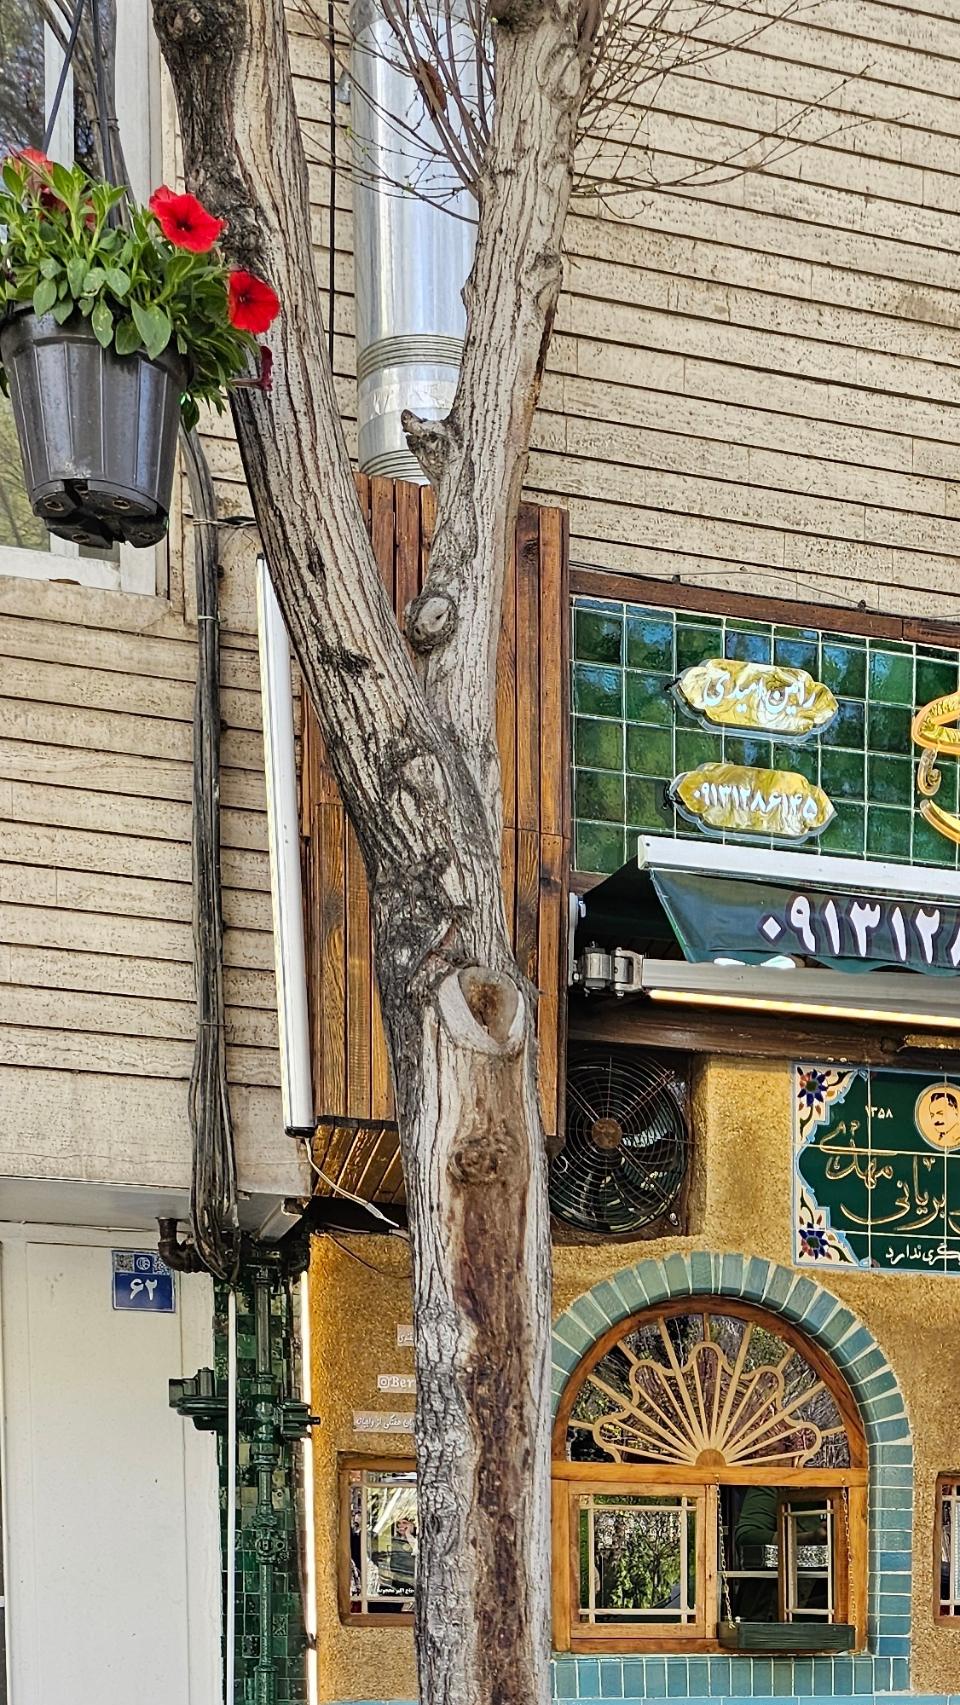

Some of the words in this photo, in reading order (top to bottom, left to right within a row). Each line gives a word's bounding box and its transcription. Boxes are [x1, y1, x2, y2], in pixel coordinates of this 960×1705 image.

[763, 676, 816, 716] رامین
[693, 782, 818, 821] ۰۹۱۳۱۲۸۶۱۴۵
[864, 1105, 894, 1119] ۱۳۵۸
[819, 1119, 898, 1190] مهدی
[840, 1155, 947, 1232] بریانی
[885, 1243, 922, 1265] ندارد
[129, 1278, 158, 1301] ۶۲
